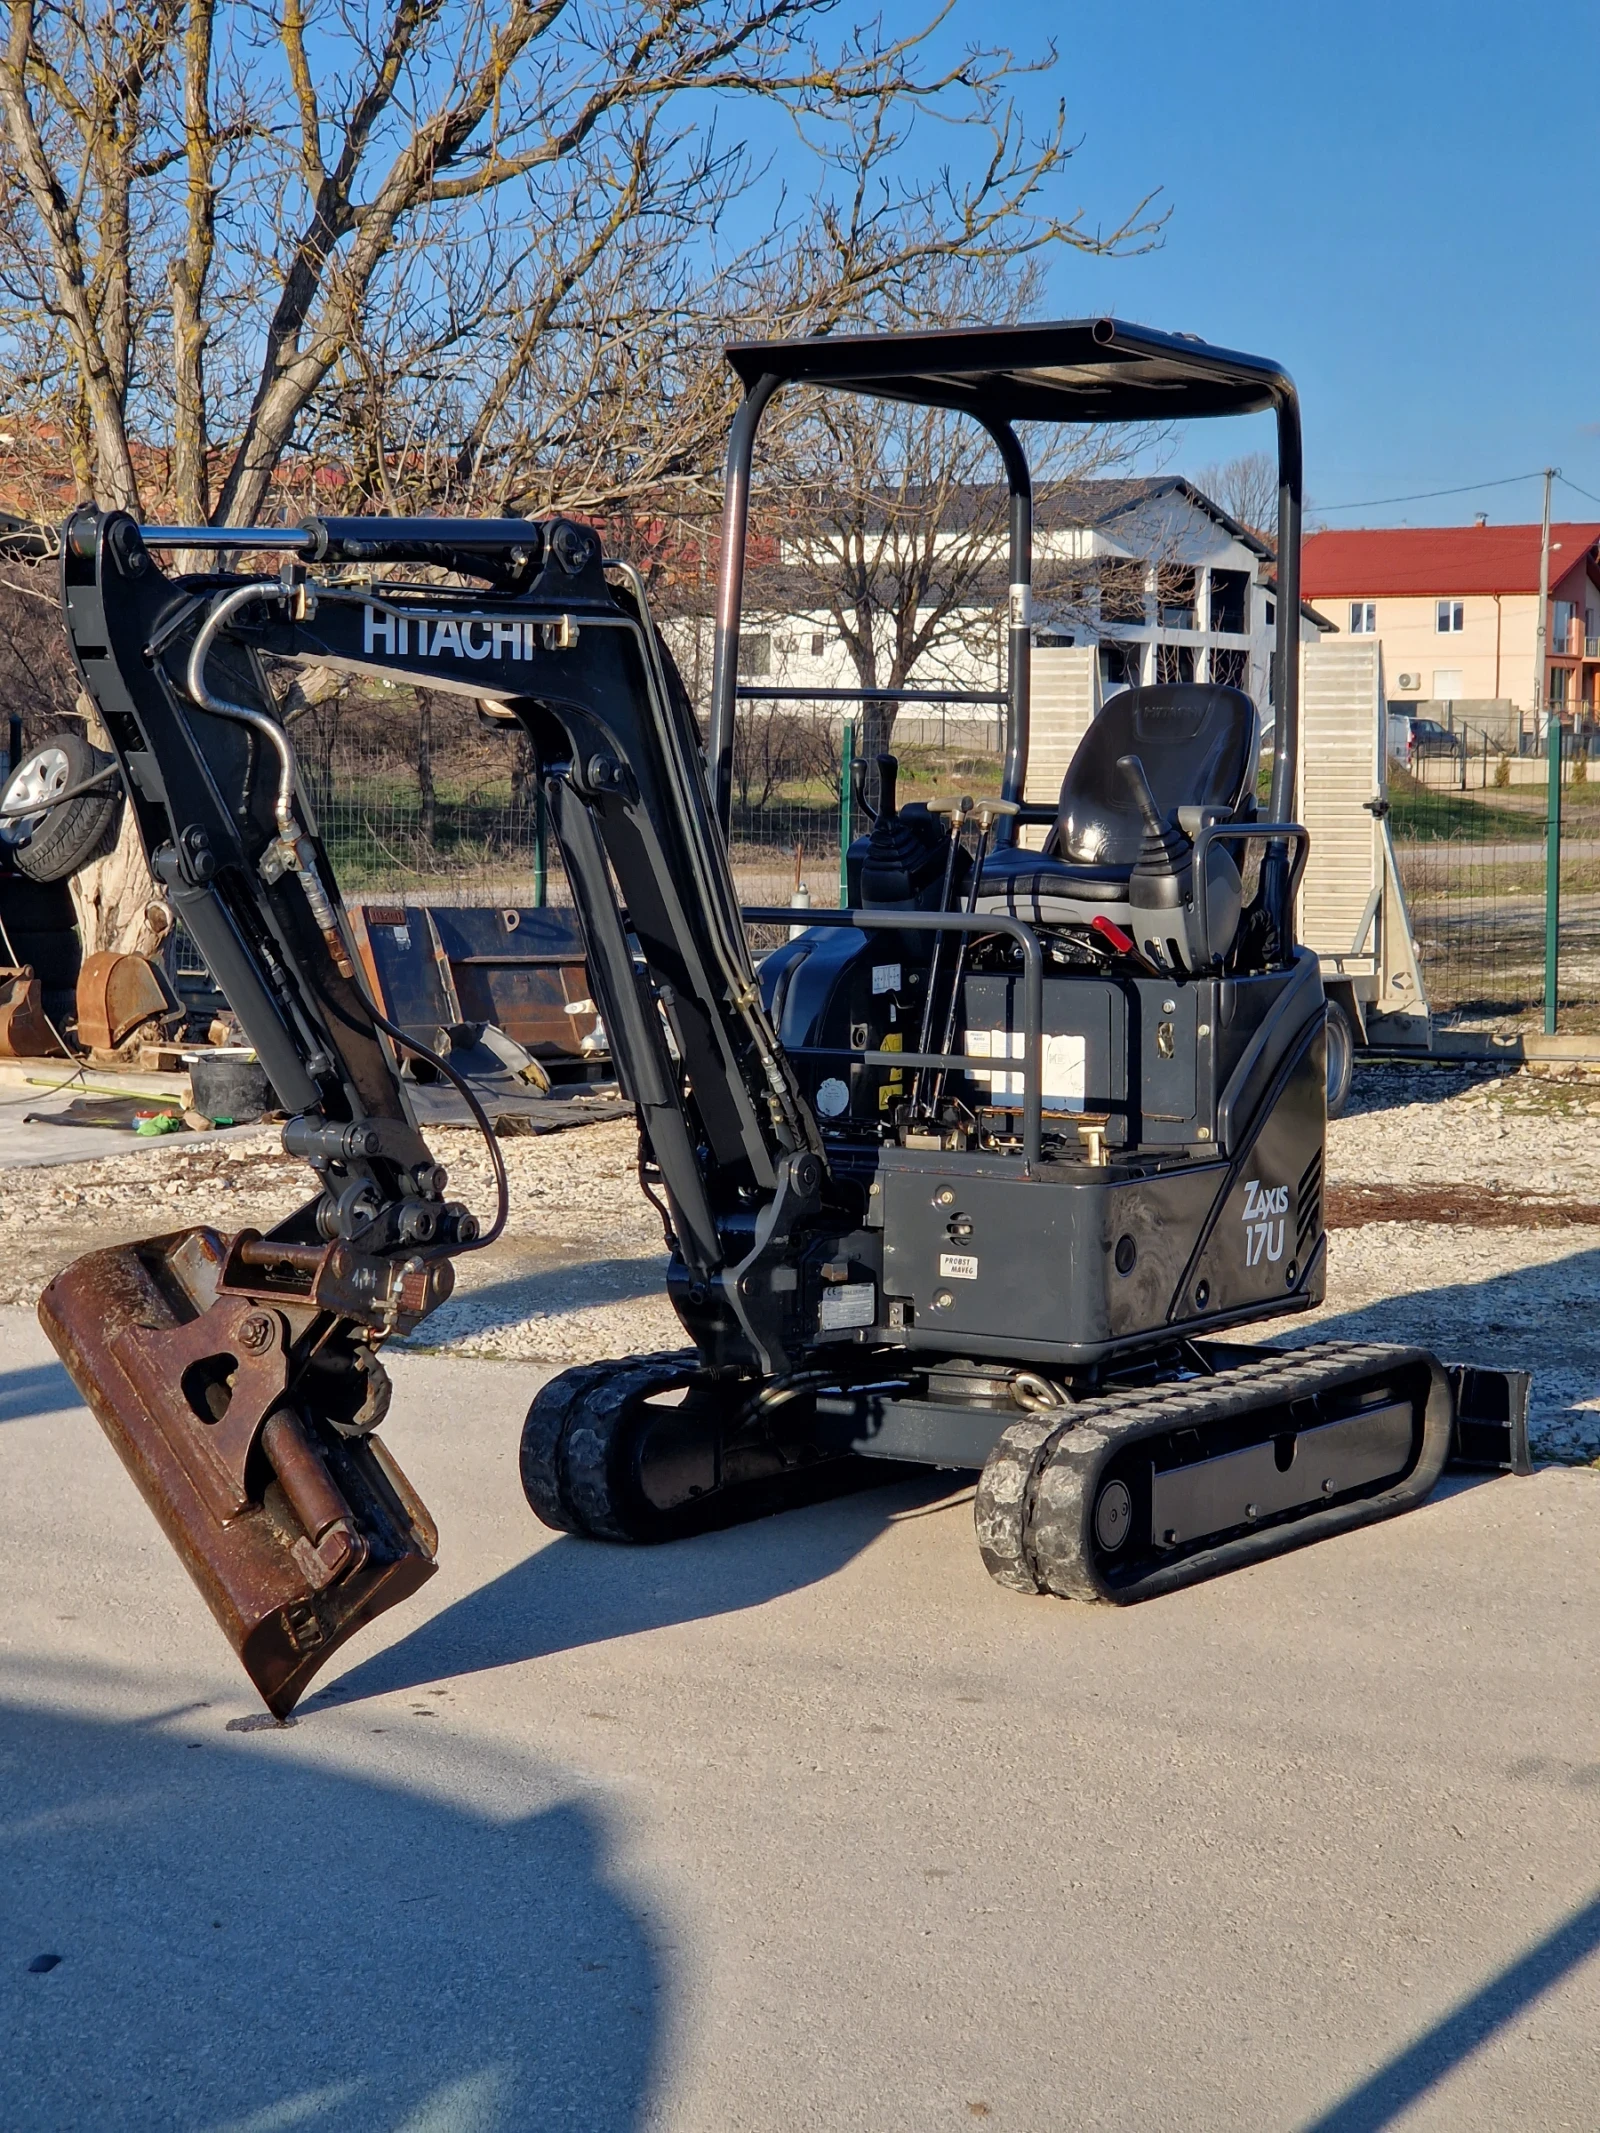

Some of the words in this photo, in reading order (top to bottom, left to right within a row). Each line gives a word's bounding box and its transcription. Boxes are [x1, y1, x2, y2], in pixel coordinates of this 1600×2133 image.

[364, 604, 533, 661] HITACHI
[1242, 1180, 1289, 1220] ZAXIS
[945, 1257, 970, 1266] PROBST
[1246, 1219, 1285, 1267] 17U
[951, 1266, 974, 1275] MAVEG
